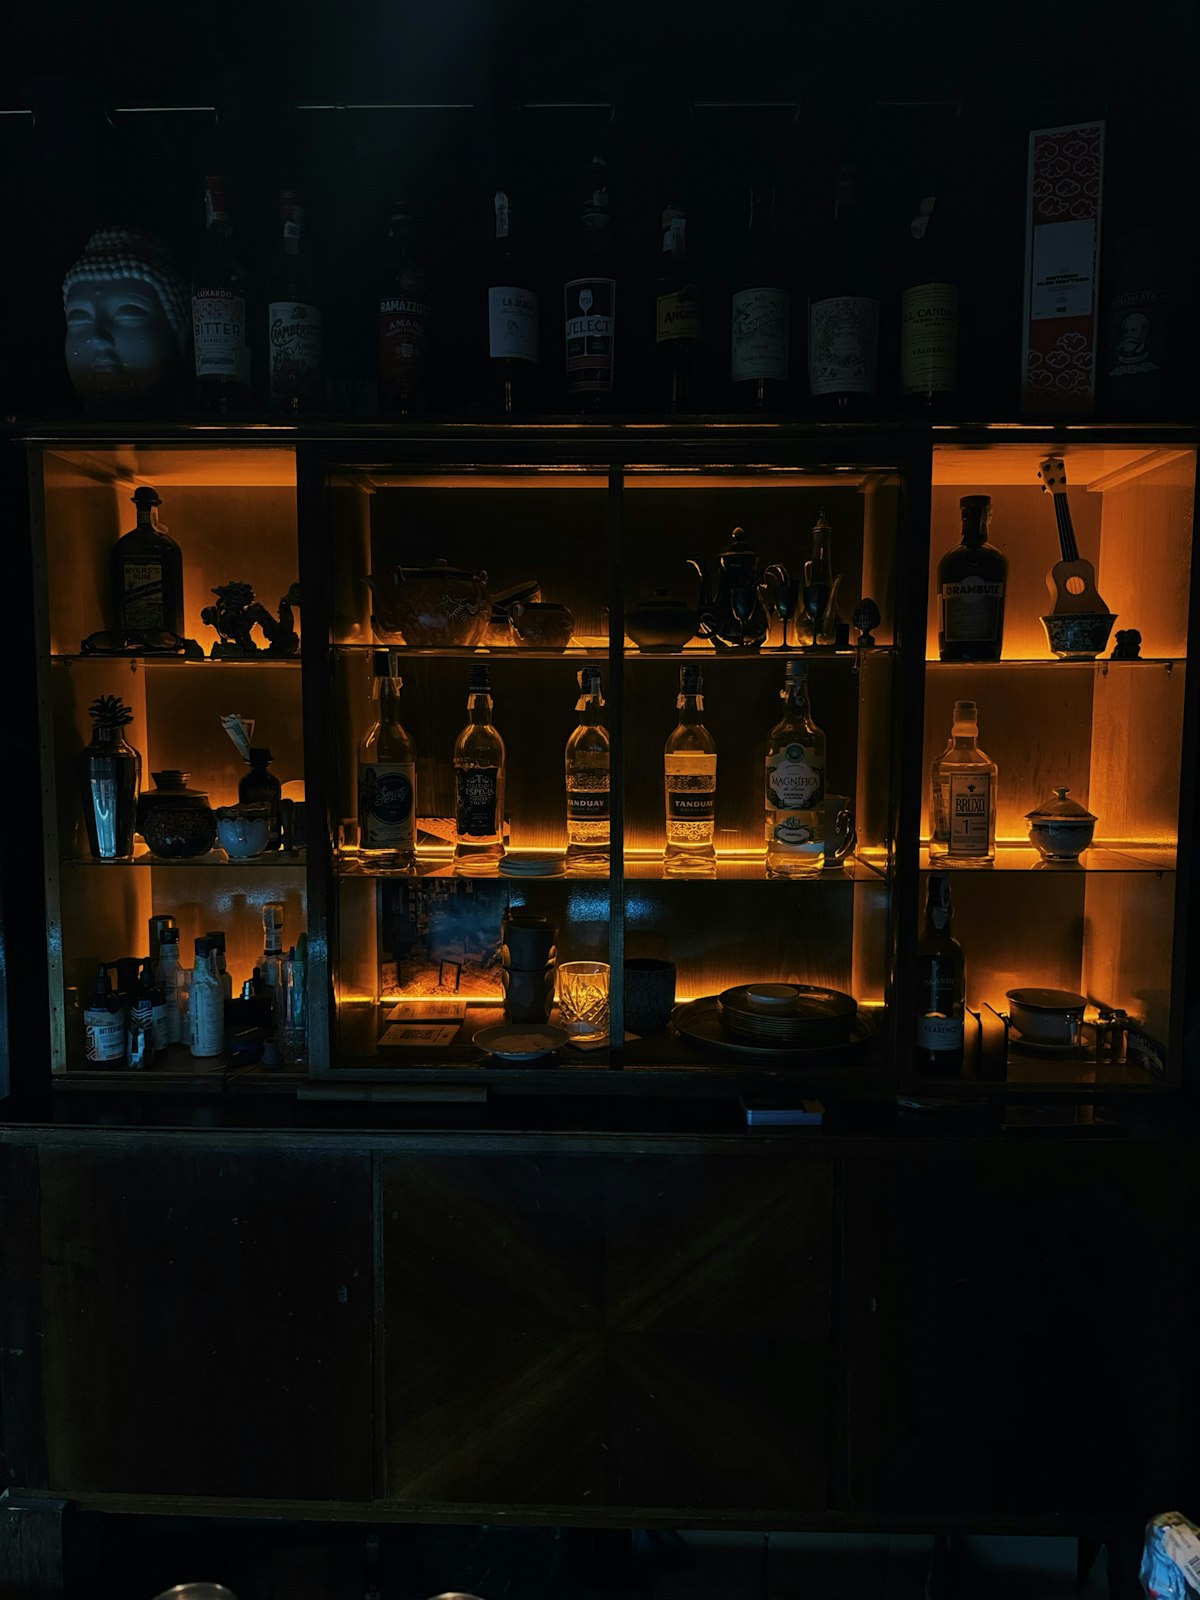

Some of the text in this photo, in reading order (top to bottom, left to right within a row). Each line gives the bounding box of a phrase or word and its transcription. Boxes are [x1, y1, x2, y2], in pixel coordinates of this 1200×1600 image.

[197, 290, 232, 298] LUXARDO
[195, 322, 241, 336] BITTER
[567, 320, 608, 335] SELECT
[946, 585, 999, 595] DRAMBUIE
[955, 798, 984, 812] BRUXO
